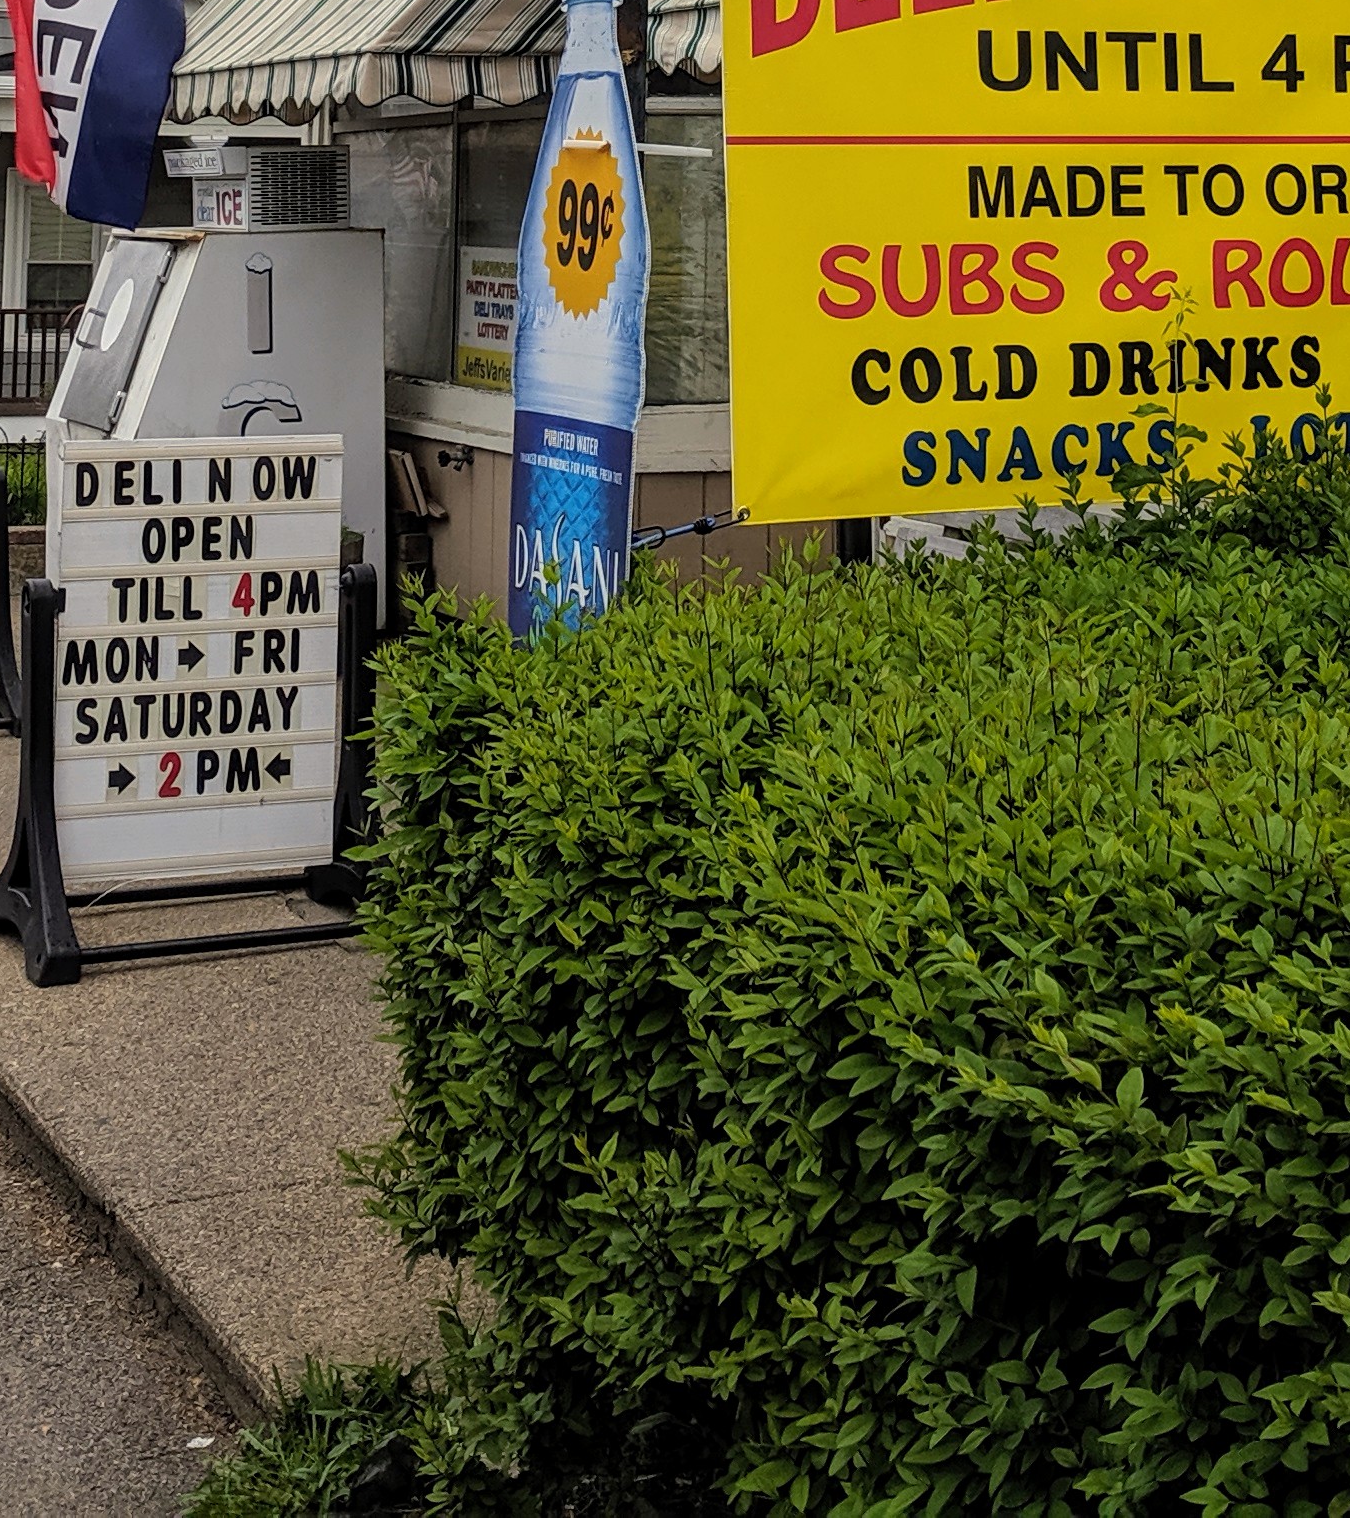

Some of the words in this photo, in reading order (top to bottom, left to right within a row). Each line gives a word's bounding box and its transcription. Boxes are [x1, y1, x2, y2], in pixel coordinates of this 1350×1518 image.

[977, 29, 1234, 94] UNTIL
[1260, 33, 1303, 94] 4
[215, 187, 243, 226] ICE
[967, 164, 1146, 219] MADE
[1164, 164, 1246, 216] TO
[818, 242, 1065, 320] SUBS
[1102, 240, 1178, 314] &
[850, 345, 1038, 408] COLD
[1068, 335, 1322, 399] DRINKS
[576, 435, 599, 457] WATER
[901, 419, 1178, 487] SNACKS
[75, 459, 182, 507] DELI
[142, 515, 253, 564] OPEN
[514, 511, 619, 614] DASANI
[112, 576, 203, 623] TILL
[232, 570, 321, 617] 4PM
[62, 635, 159, 685] MON
[234, 628, 300, 674] FRI
[75, 685, 299, 744] SATURDAY
